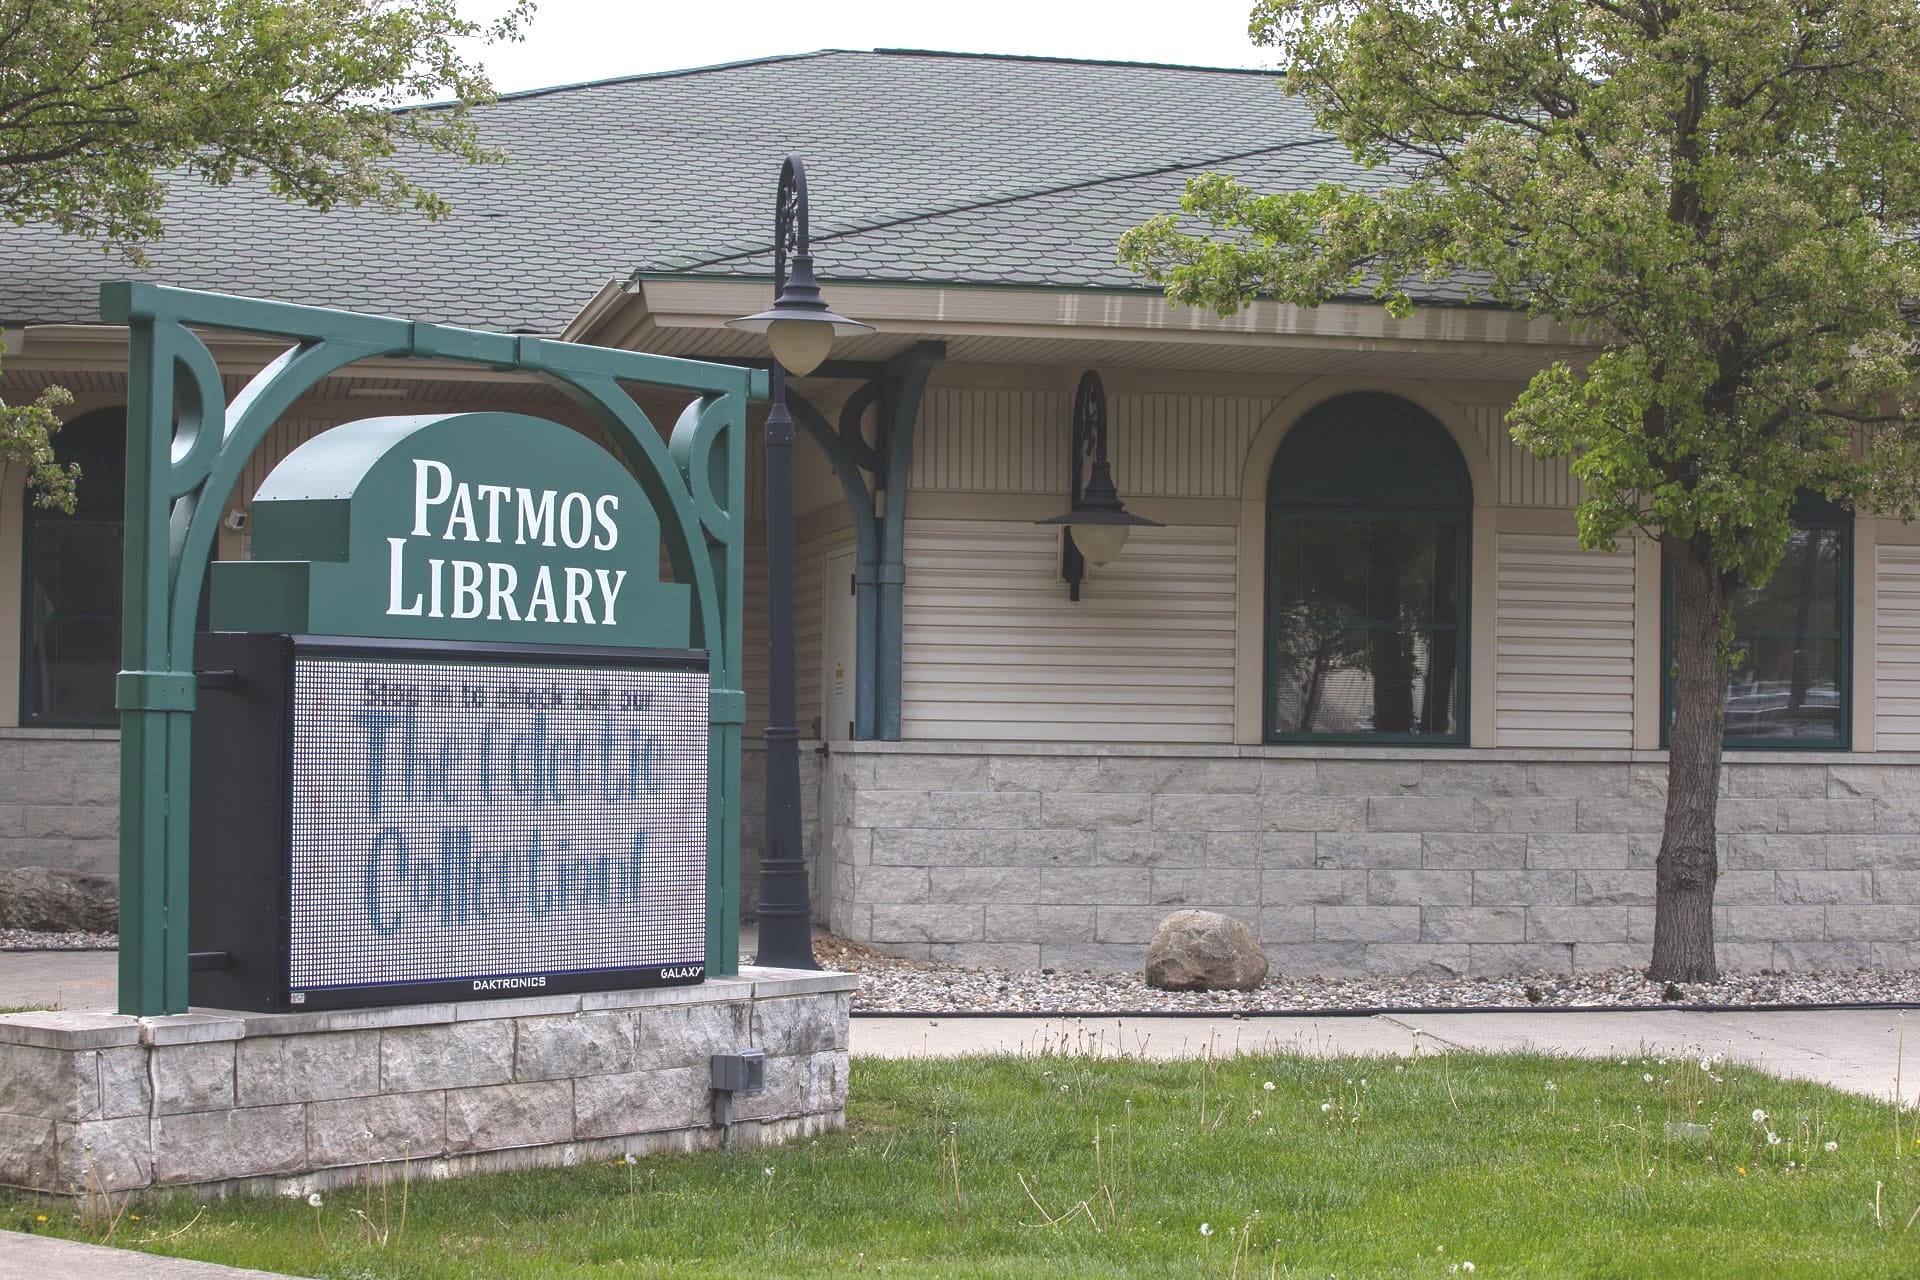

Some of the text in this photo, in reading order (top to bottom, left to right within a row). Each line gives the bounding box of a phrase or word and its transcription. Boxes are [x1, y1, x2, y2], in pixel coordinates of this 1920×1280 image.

[411, 459, 619, 551] PATMOS
[386, 538, 627, 625] LIBRARY
[363, 677, 656, 712] Stop in to check out our
[352, 709, 665, 822] The Eclectic
[473, 976, 546, 991] DAKTRONICS
